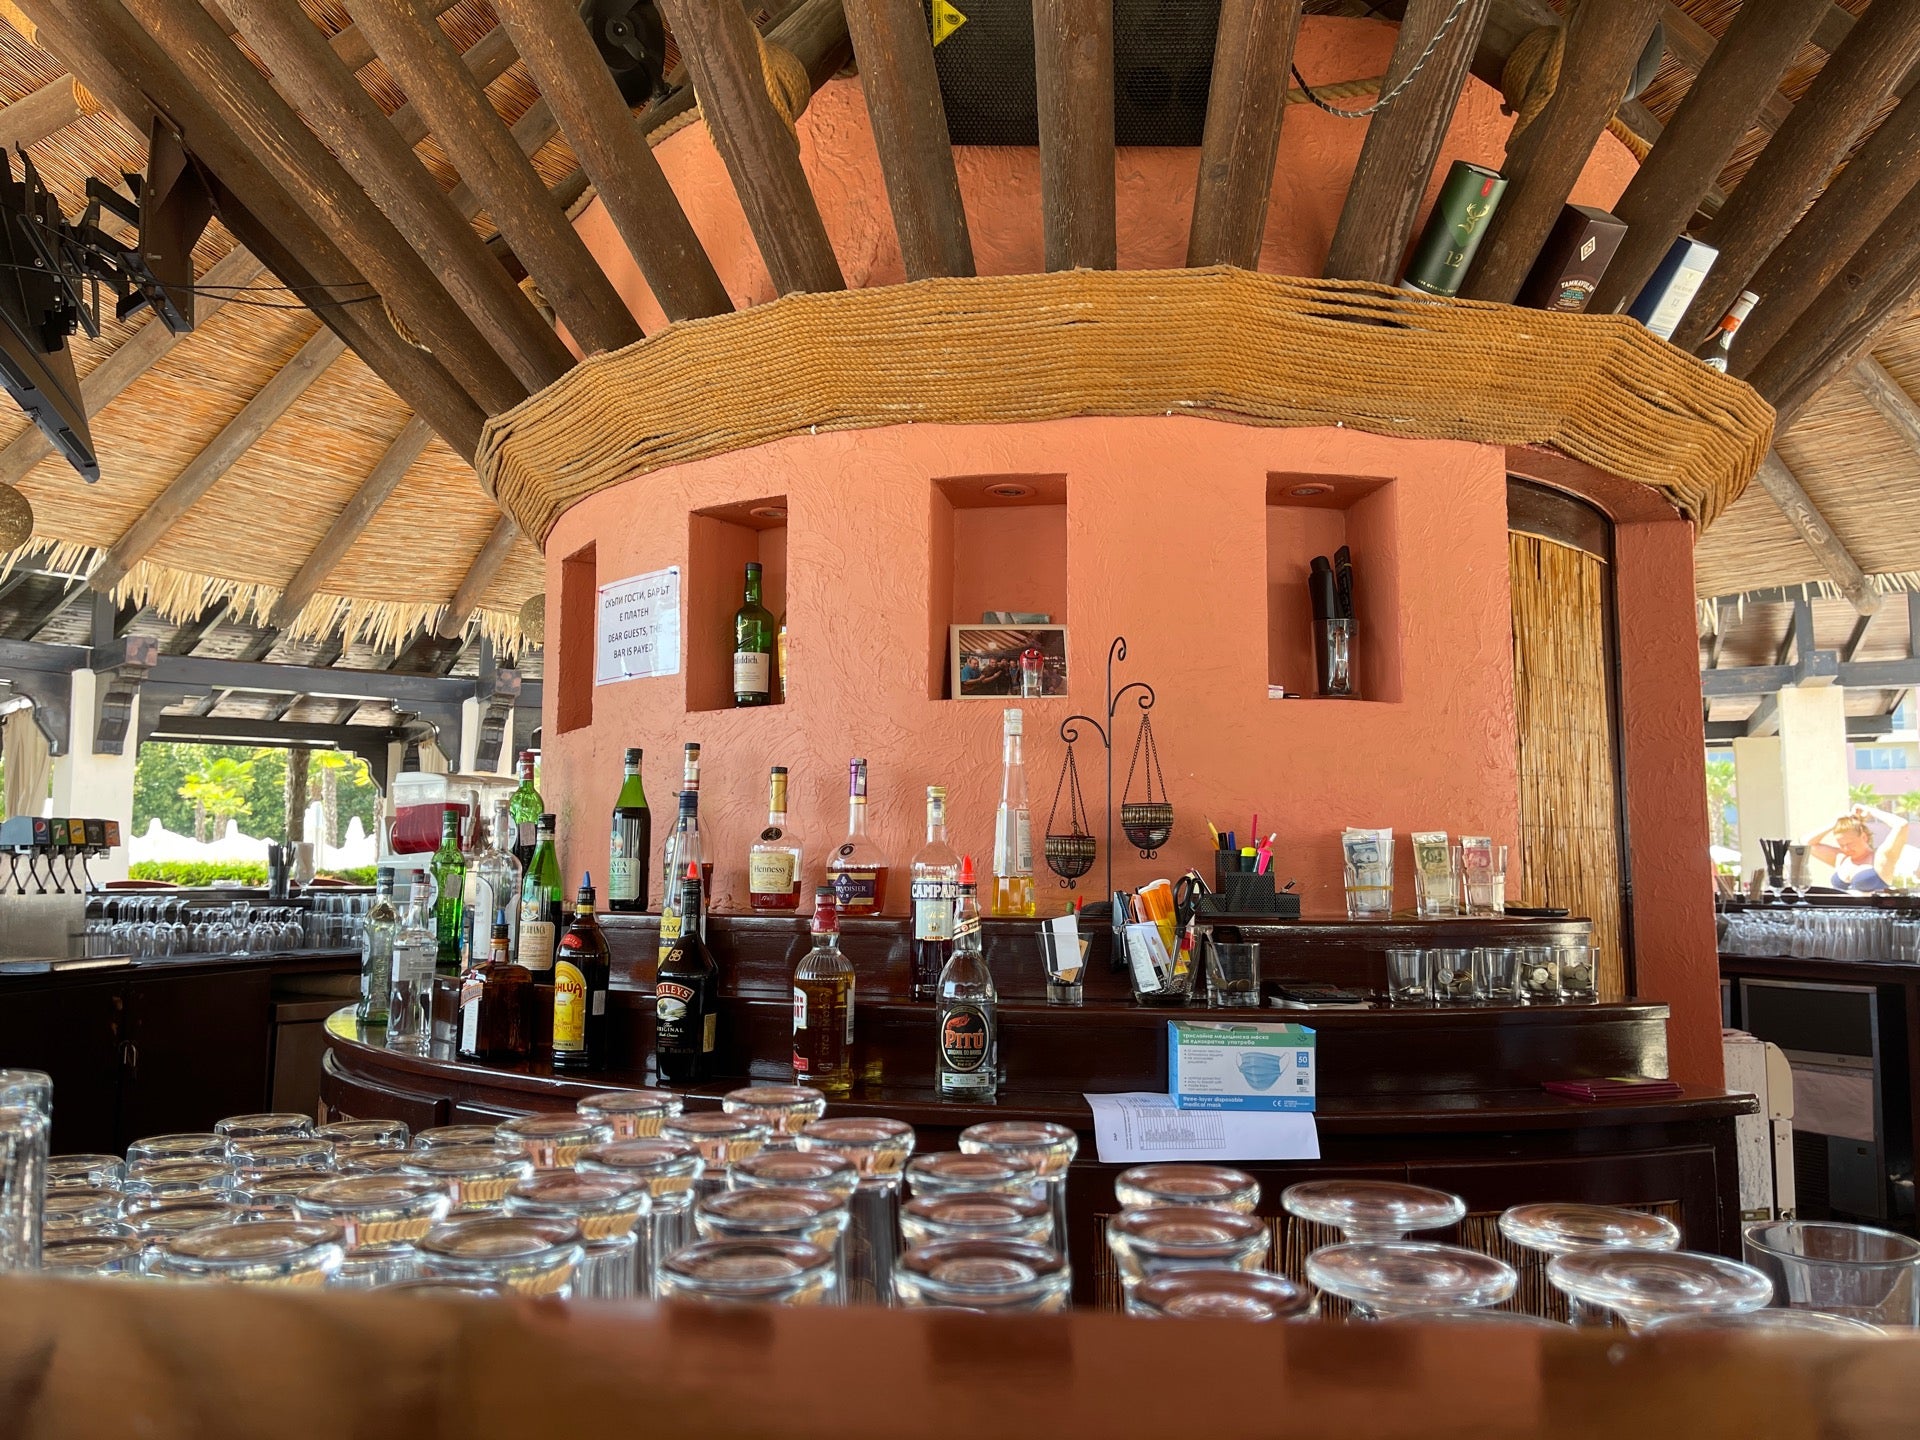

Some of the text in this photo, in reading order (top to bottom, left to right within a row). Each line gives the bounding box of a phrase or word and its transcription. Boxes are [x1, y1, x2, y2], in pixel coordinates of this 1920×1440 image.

[1444, 250, 1464, 268] 12
[605, 585, 670, 609] СКЪПИ ГОСТИ, БАРЪТ
[624, 607, 649, 620] ПЛАТЕН
[608, 631, 623, 643] DEAR
[623, 626, 648, 640] GUESTS,
[613, 643, 654, 659] BAR IS PAYED
[754, 865, 785, 874] Hennessy
[945, 1028, 984, 1048] PITÚ
